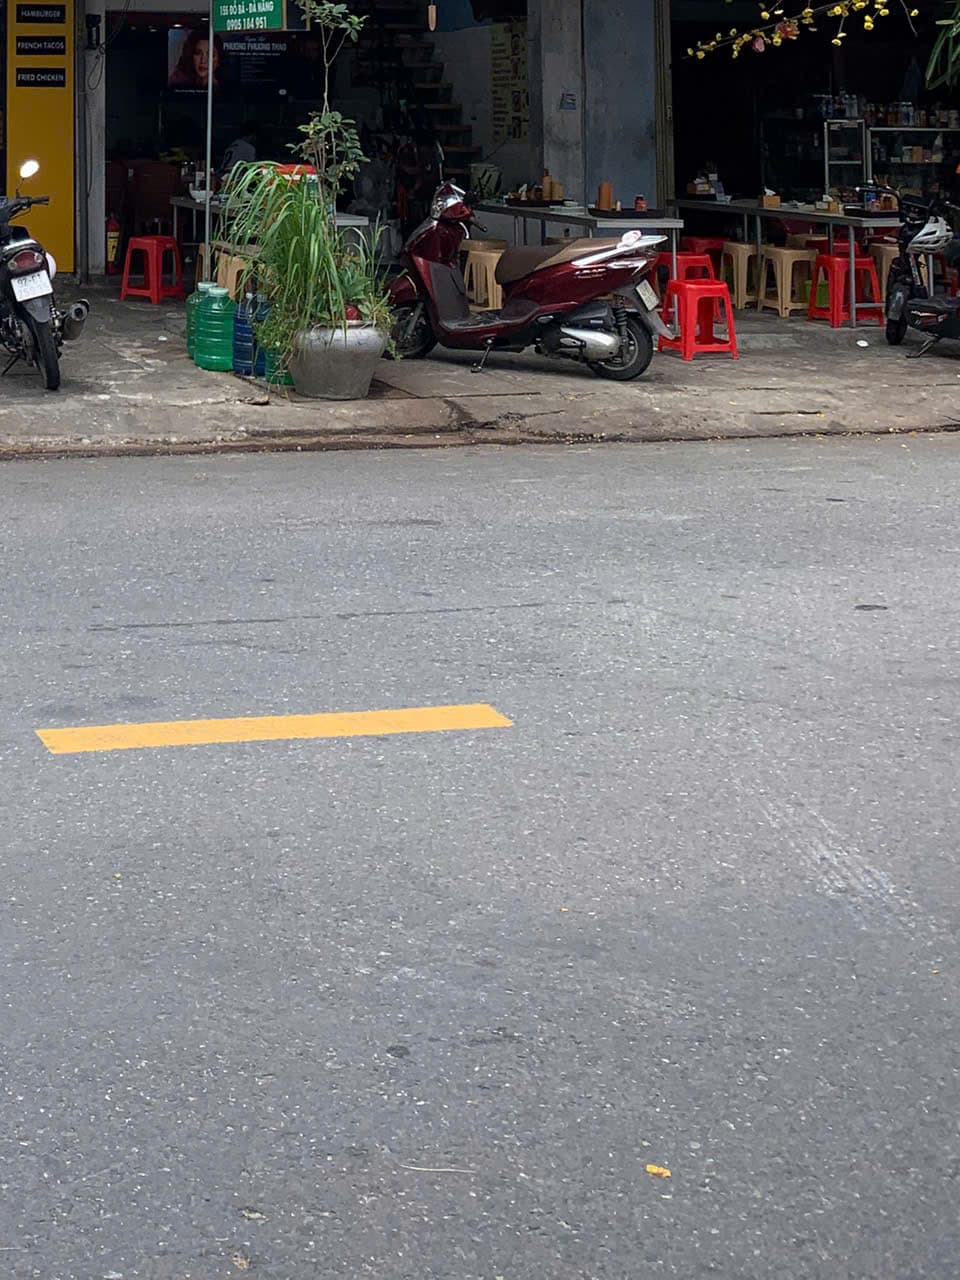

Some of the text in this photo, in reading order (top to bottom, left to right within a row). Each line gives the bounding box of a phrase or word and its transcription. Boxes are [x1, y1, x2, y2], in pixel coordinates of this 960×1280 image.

[21, 9, 60, 18] HAMBURGER
[226, 18, 242, 31] 0905
[255, 16, 267, 29] 951
[17, 41, 65, 50] FRENCH TACOS
[17, 73, 64, 81] FRIED CHICKEN
